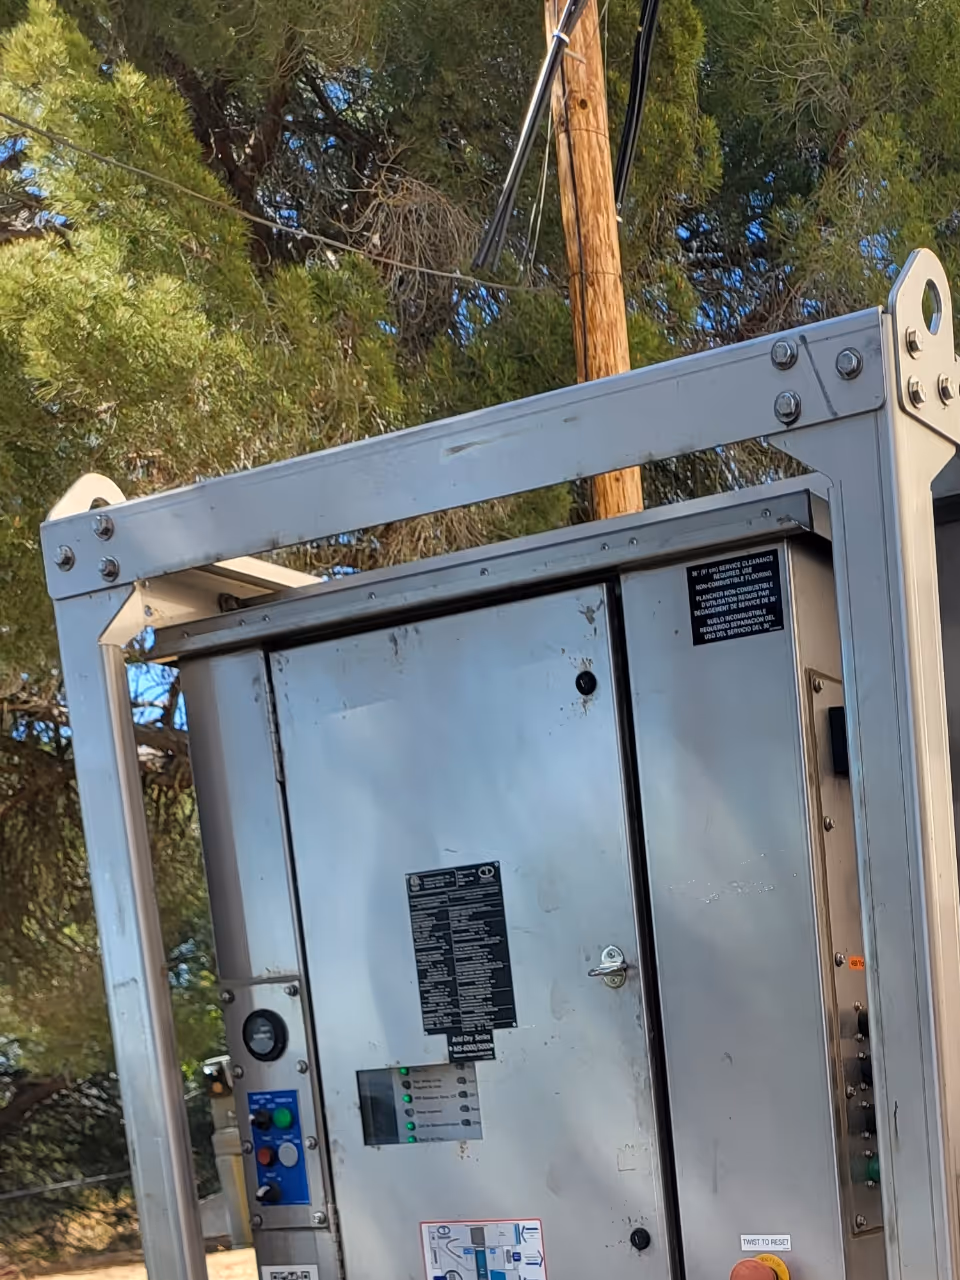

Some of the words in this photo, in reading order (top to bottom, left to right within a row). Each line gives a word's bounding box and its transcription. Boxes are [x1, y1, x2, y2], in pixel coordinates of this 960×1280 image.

[719, 561, 741, 572] SERVICE
[742, 555, 774, 567] CLEARANCE
[695, 575, 745, 590] NON-COMBUSTIBLE
[696, 591, 724, 602] PLANCHER
[724, 581, 774, 596] NON-COMBUSTIBLE
[758, 589, 770, 598] PAR
[738, 598, 760, 608] SERVICE
[706, 616, 725, 625] SUELO
[725, 608, 767, 621] INCOMBUSTIBLE
[765, 614, 775, 622] DEL
[727, 626, 751, 636] SERVICIO
[743, 1238, 760, 1246] TWIST
[762, 1238, 769, 1246] TO
[771, 1238, 789, 1246] RESET
